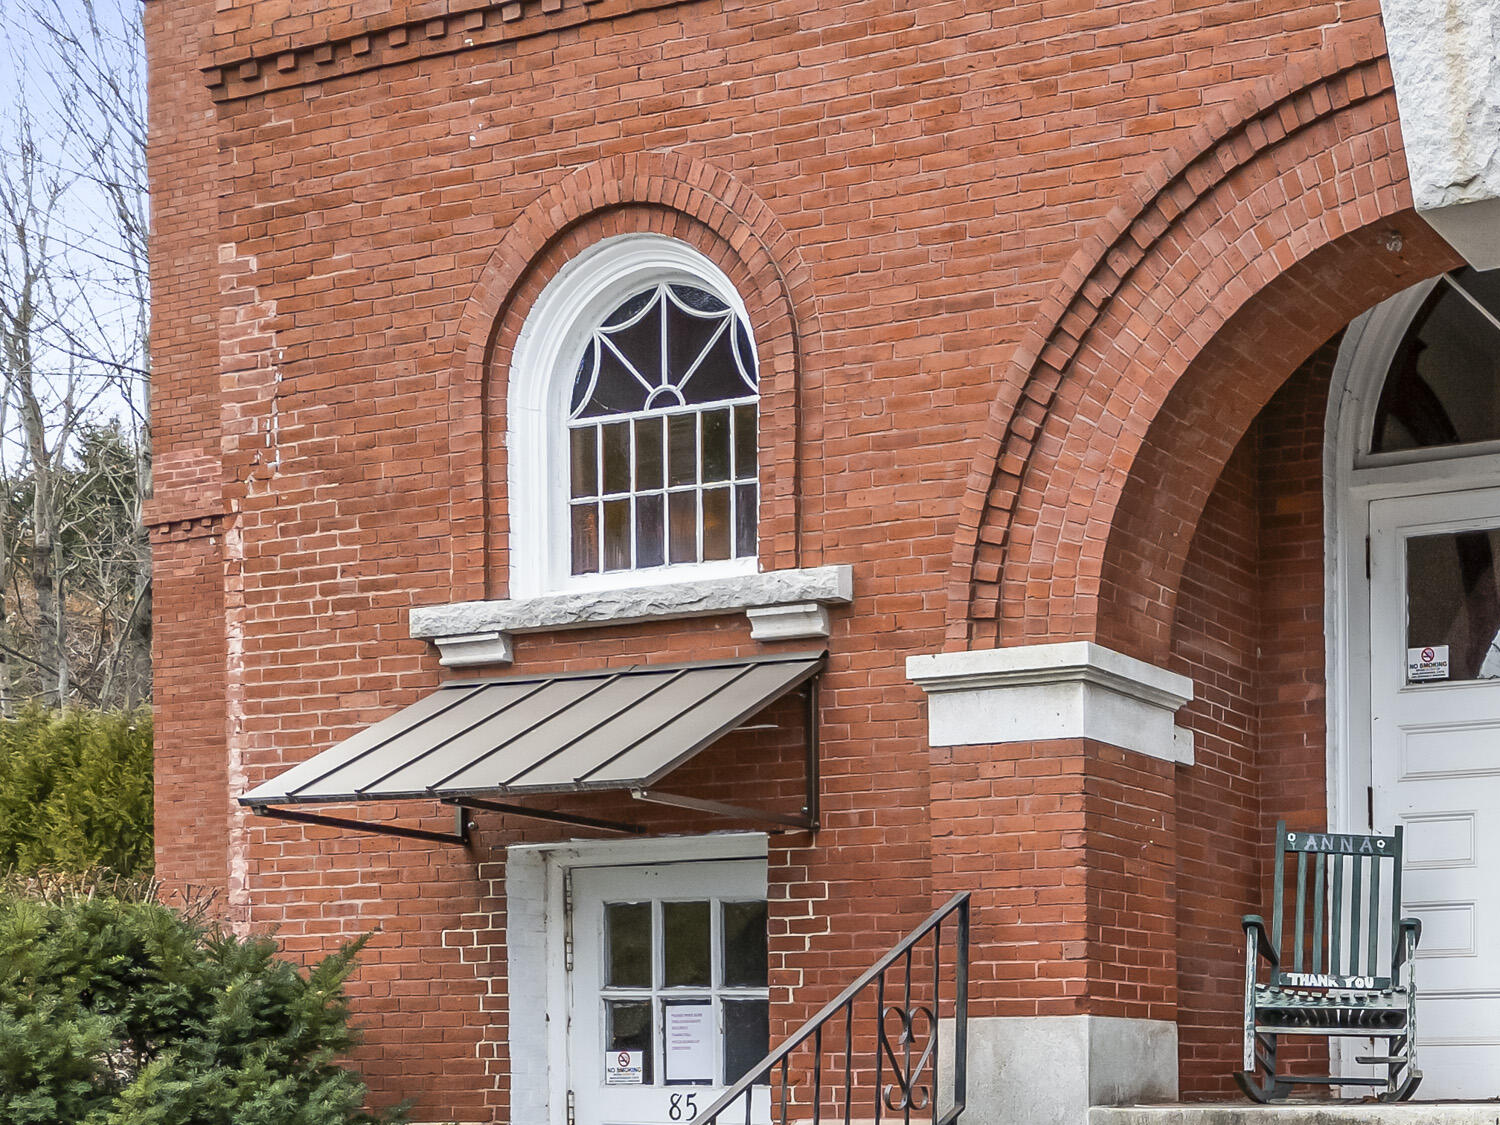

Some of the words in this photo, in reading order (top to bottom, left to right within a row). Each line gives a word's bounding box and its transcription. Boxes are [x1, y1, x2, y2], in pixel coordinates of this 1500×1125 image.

[1304, 834, 1374, 854] ANNA
[1287, 972, 1338, 988] THANK
[1344, 975, 1374, 989] YOU
[668, 1093, 698, 1121] 85
